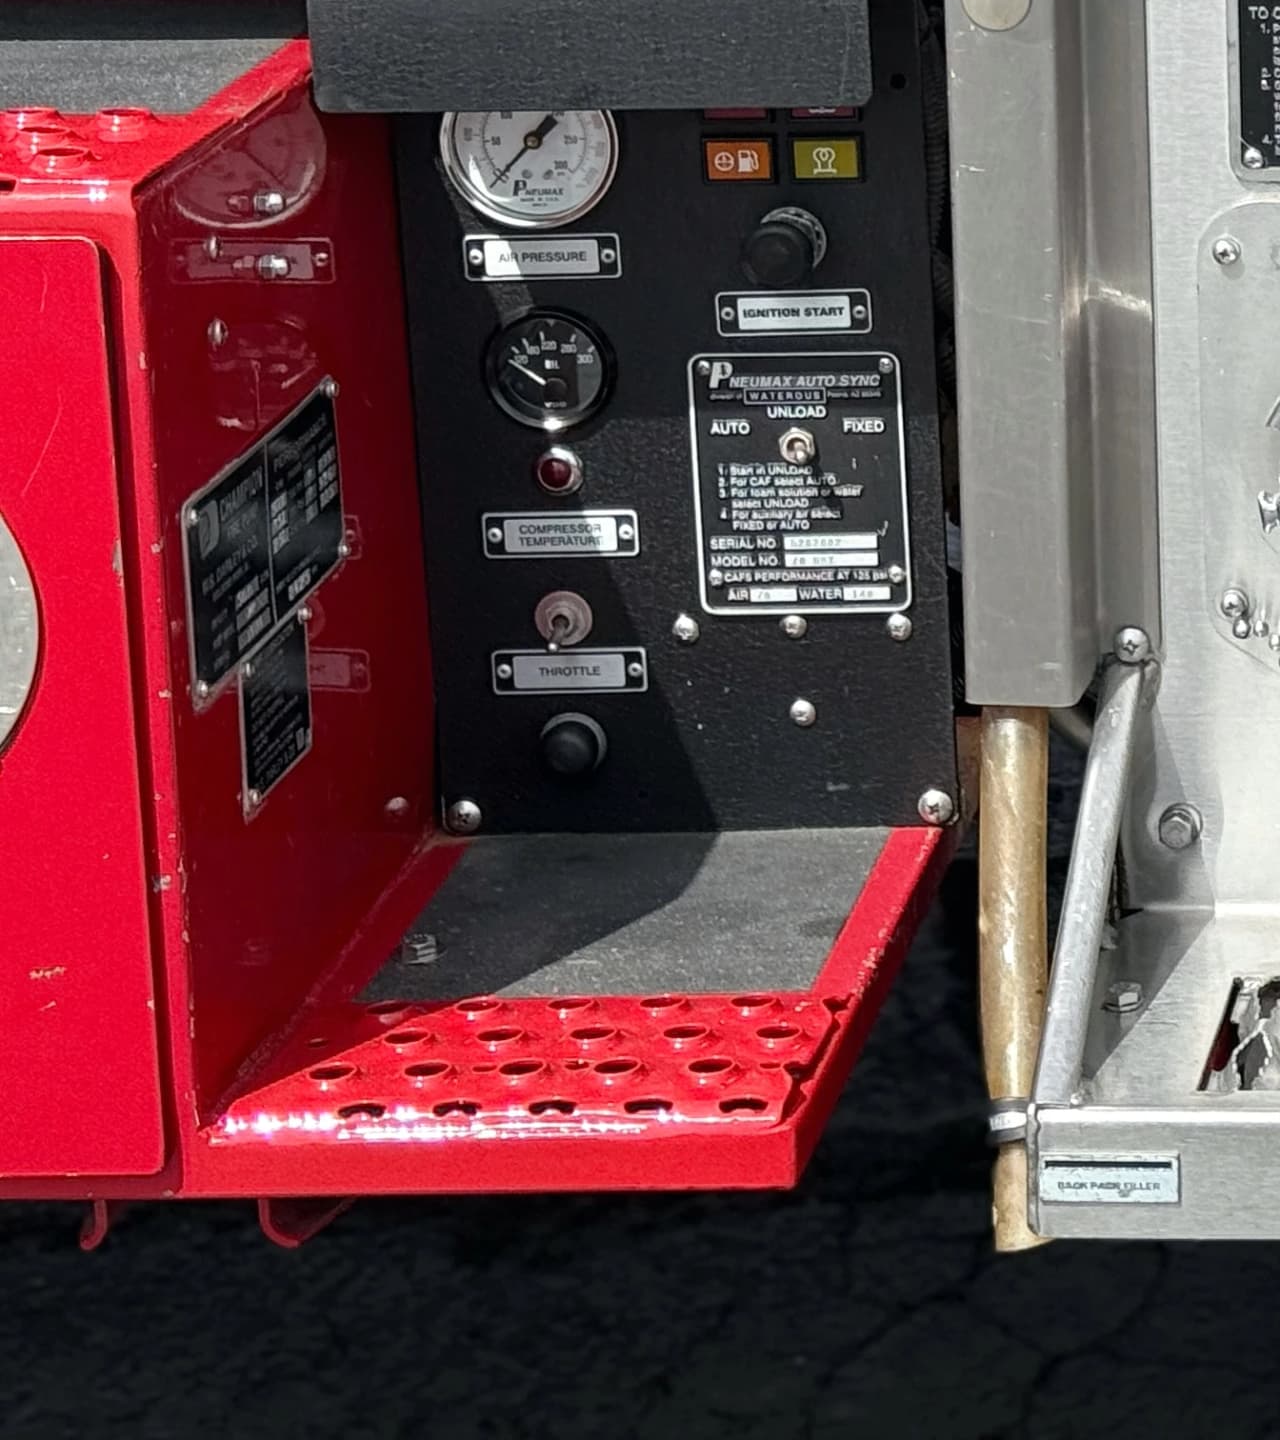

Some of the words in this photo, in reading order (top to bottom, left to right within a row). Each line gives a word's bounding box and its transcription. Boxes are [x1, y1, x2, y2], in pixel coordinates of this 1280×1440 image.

[1248, 6, 1269, 20] TO
[490, 136, 501, 146] 50
[498, 253, 519, 263] AIR
[521, 251, 587, 263] PRESSURE
[743, 307, 801, 319] IGNITION
[804, 306, 845, 318] START
[709, 361, 794, 389] PNEUMAX
[794, 374, 836, 388] AUTO
[838, 374, 881, 387] SYNC
[750, 390, 821, 401] WATEROUS
[767, 406, 827, 420] UNLOAD
[710, 422, 750, 436] AUTO
[842, 419, 885, 433] FIXED
[730, 464, 754, 476] Start
[768, 463, 814, 476] UNLOAD
[730, 477, 748, 487] For
[749, 476, 772, 487] CAF
[806, 476, 837, 487] AUTO
[731, 488, 748, 498] For
[751, 487, 776, 497] foam
[778, 487, 819, 497] solution
[833, 486, 863, 497] water
[763, 498, 810, 509] UNLOAD
[732, 510, 749, 520] For
[518, 523, 602, 535] COMPRESSOR
[732, 520, 764, 531] FIXED
[766, 521, 777, 531] or
[779, 519, 810, 530] AUTO
[519, 535, 604, 547] TEMPERATURE
[709, 538, 755, 550] SERIAL
[710, 555, 756, 568] MODEL
[724, 571, 752, 583] CAFS
[754, 571, 835, 583] PERFORMANCE
[836, 571, 851, 581] AT
[853, 571, 870, 581] 125
[728, 587, 749, 601] AIR
[800, 587, 843, 601] WATER
[538, 665, 602, 677] THROTTLE
[1057, 1182, 1088, 1190] BACK
[1123, 1182, 1161, 1190] FILLER
